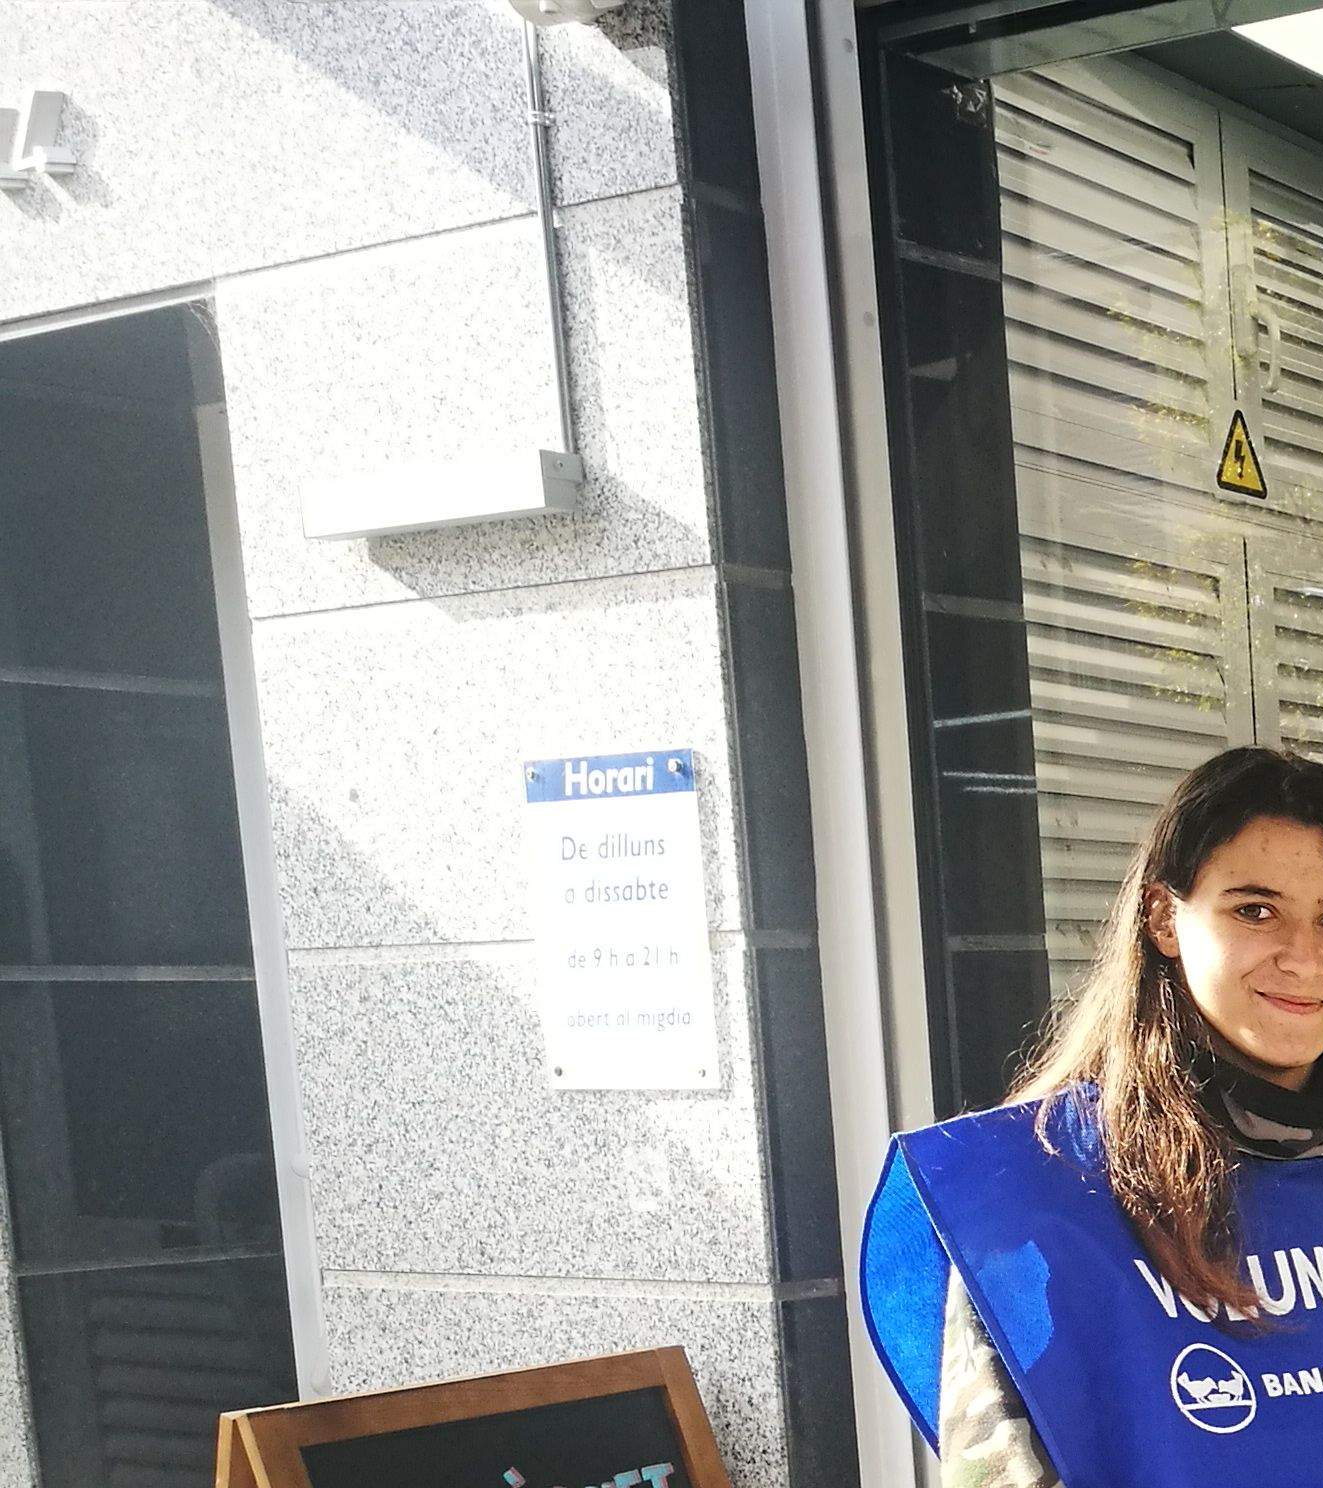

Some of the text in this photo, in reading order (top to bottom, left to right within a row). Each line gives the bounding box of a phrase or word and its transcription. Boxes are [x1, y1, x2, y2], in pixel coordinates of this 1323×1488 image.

[564, 757, 654, 796] Horari
[561, 833, 665, 861] De dilluns
[564, 877, 669, 904] a dissabte
[568, 949, 586, 968] de
[593, 948, 602, 968] 9
[609, 948, 618, 967] h
[626, 951, 635, 967] a
[670, 947, 679, 967] h
[567, 1008, 691, 1032] obert al migdia
